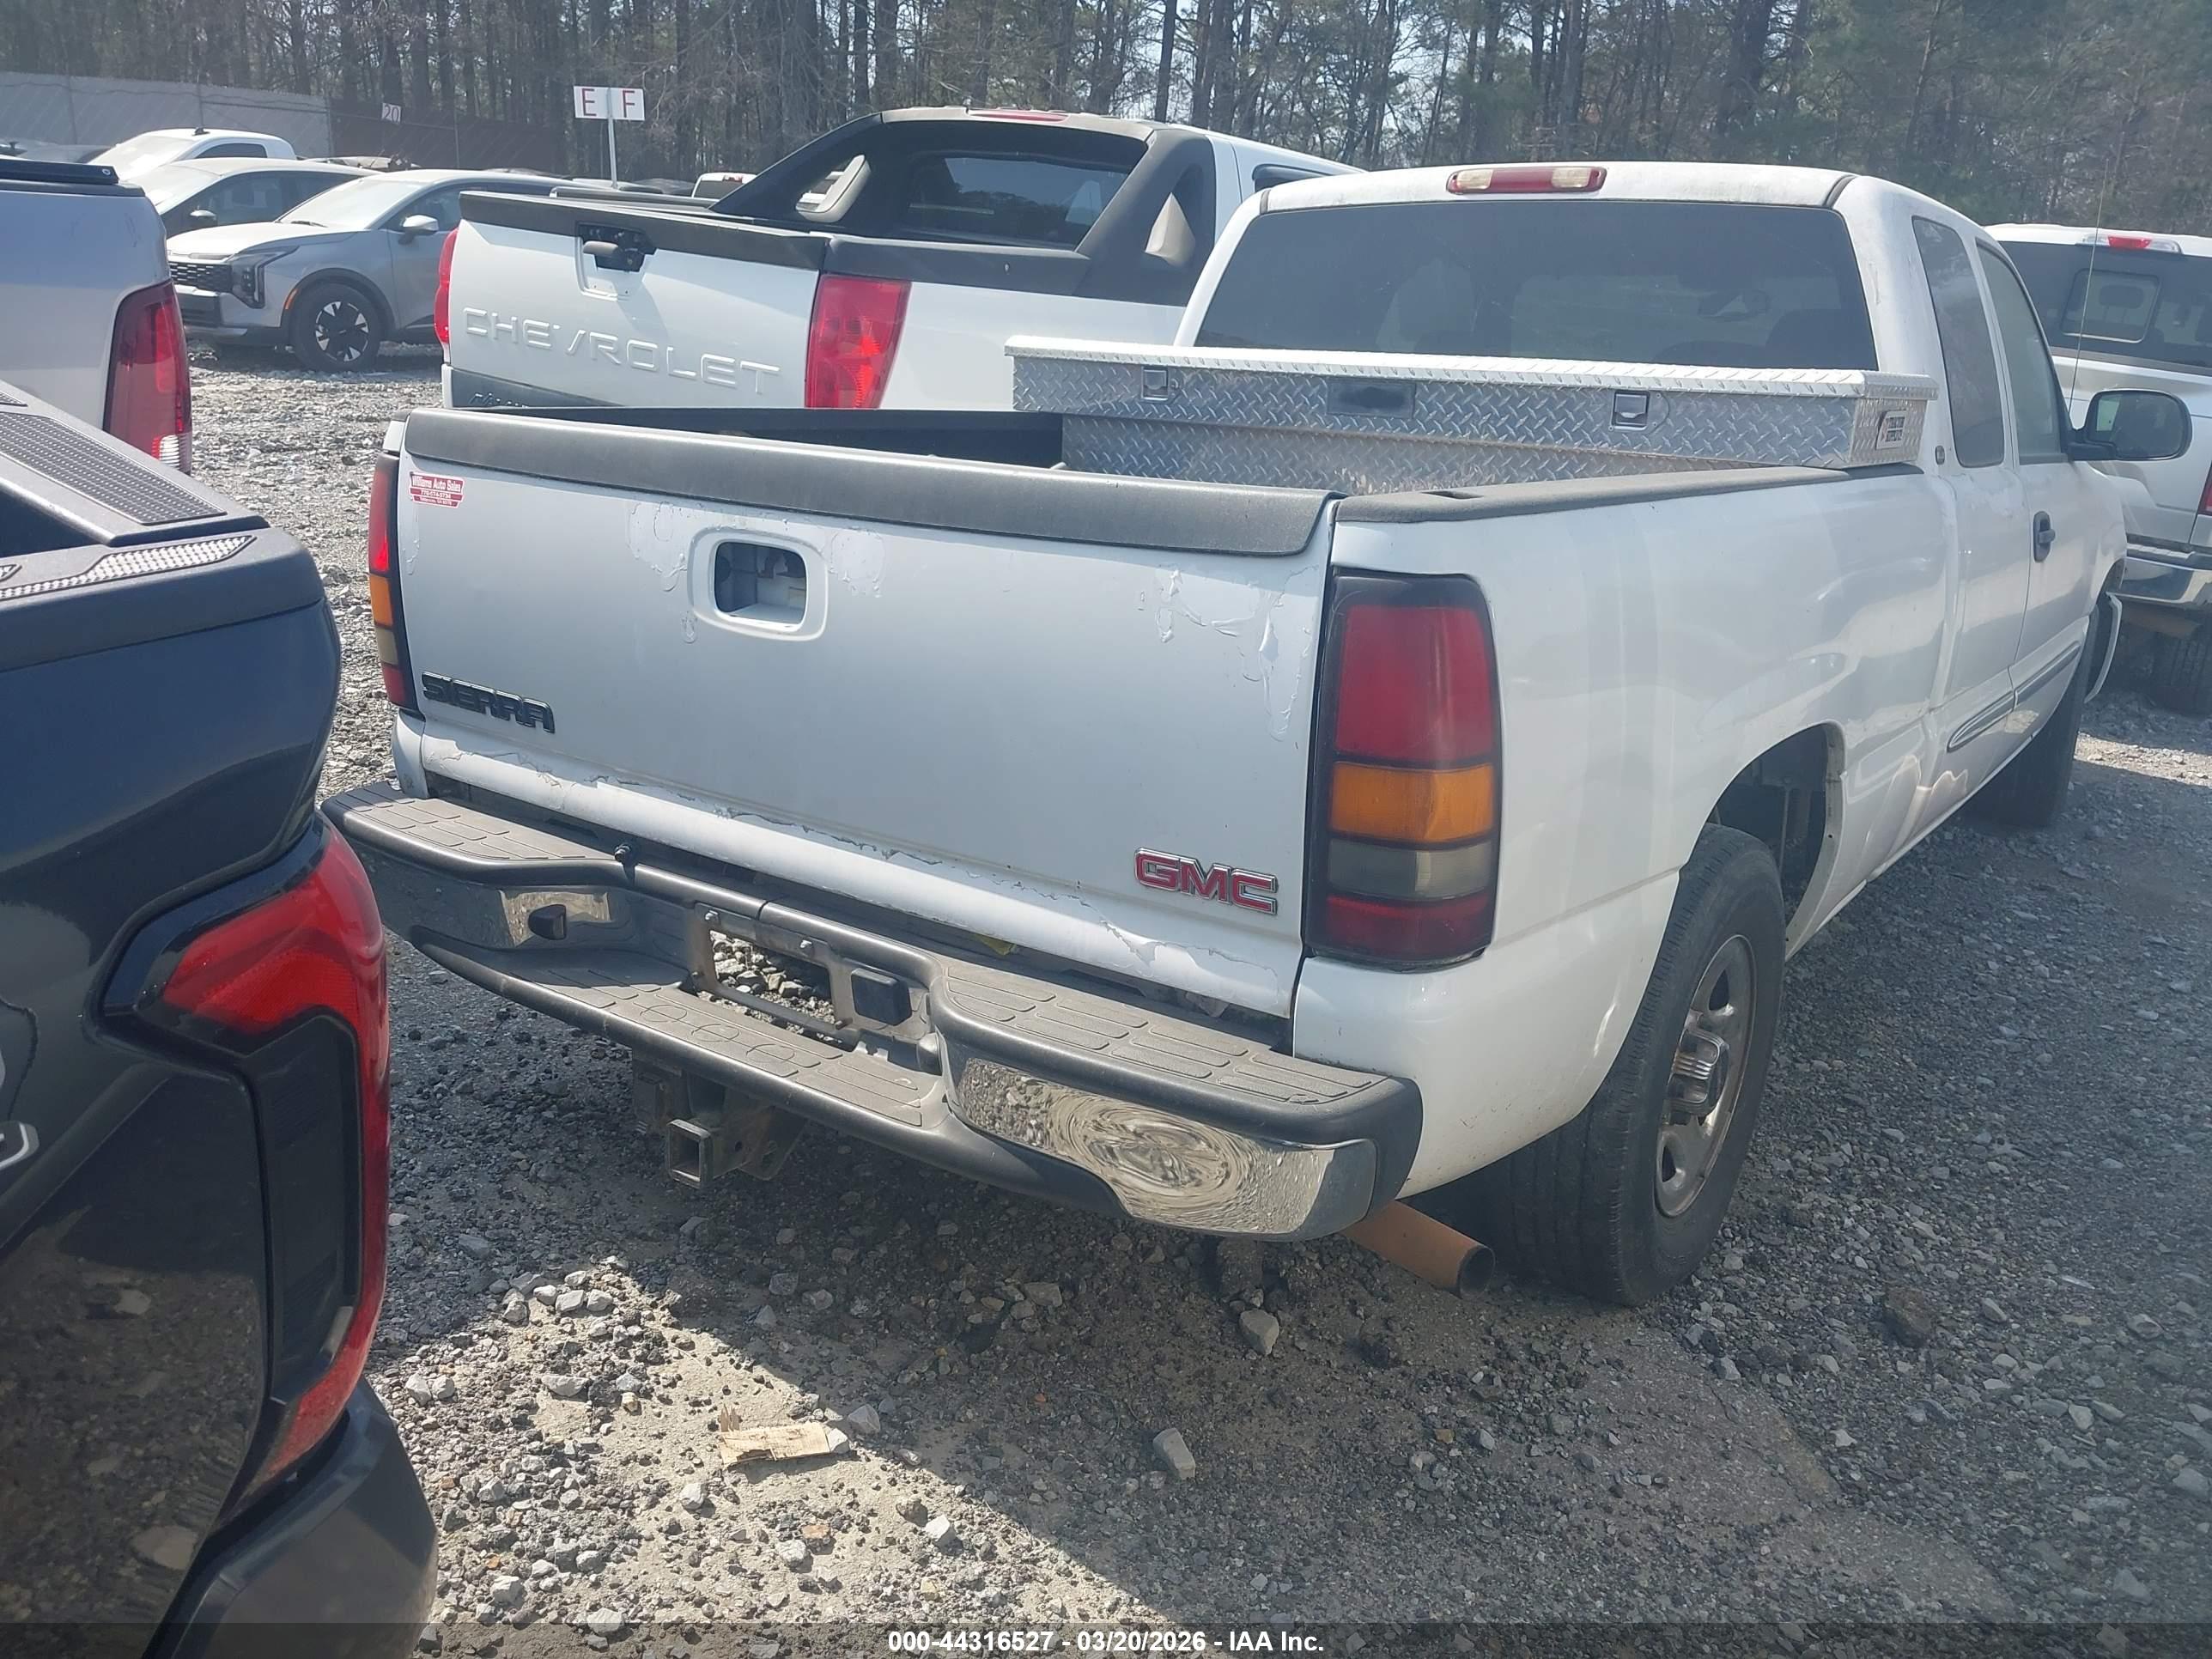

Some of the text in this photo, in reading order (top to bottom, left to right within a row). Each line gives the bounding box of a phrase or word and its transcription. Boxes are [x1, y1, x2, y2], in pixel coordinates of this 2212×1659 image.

[384, 104, 400, 123] 20
[581, 88, 635, 118] E F
[462, 307, 781, 396] CHEVROLET
[412, 475, 461, 492] Williams Auto Sales
[421, 672, 556, 734] SIERRA
[1134, 847, 1279, 916] GMC
